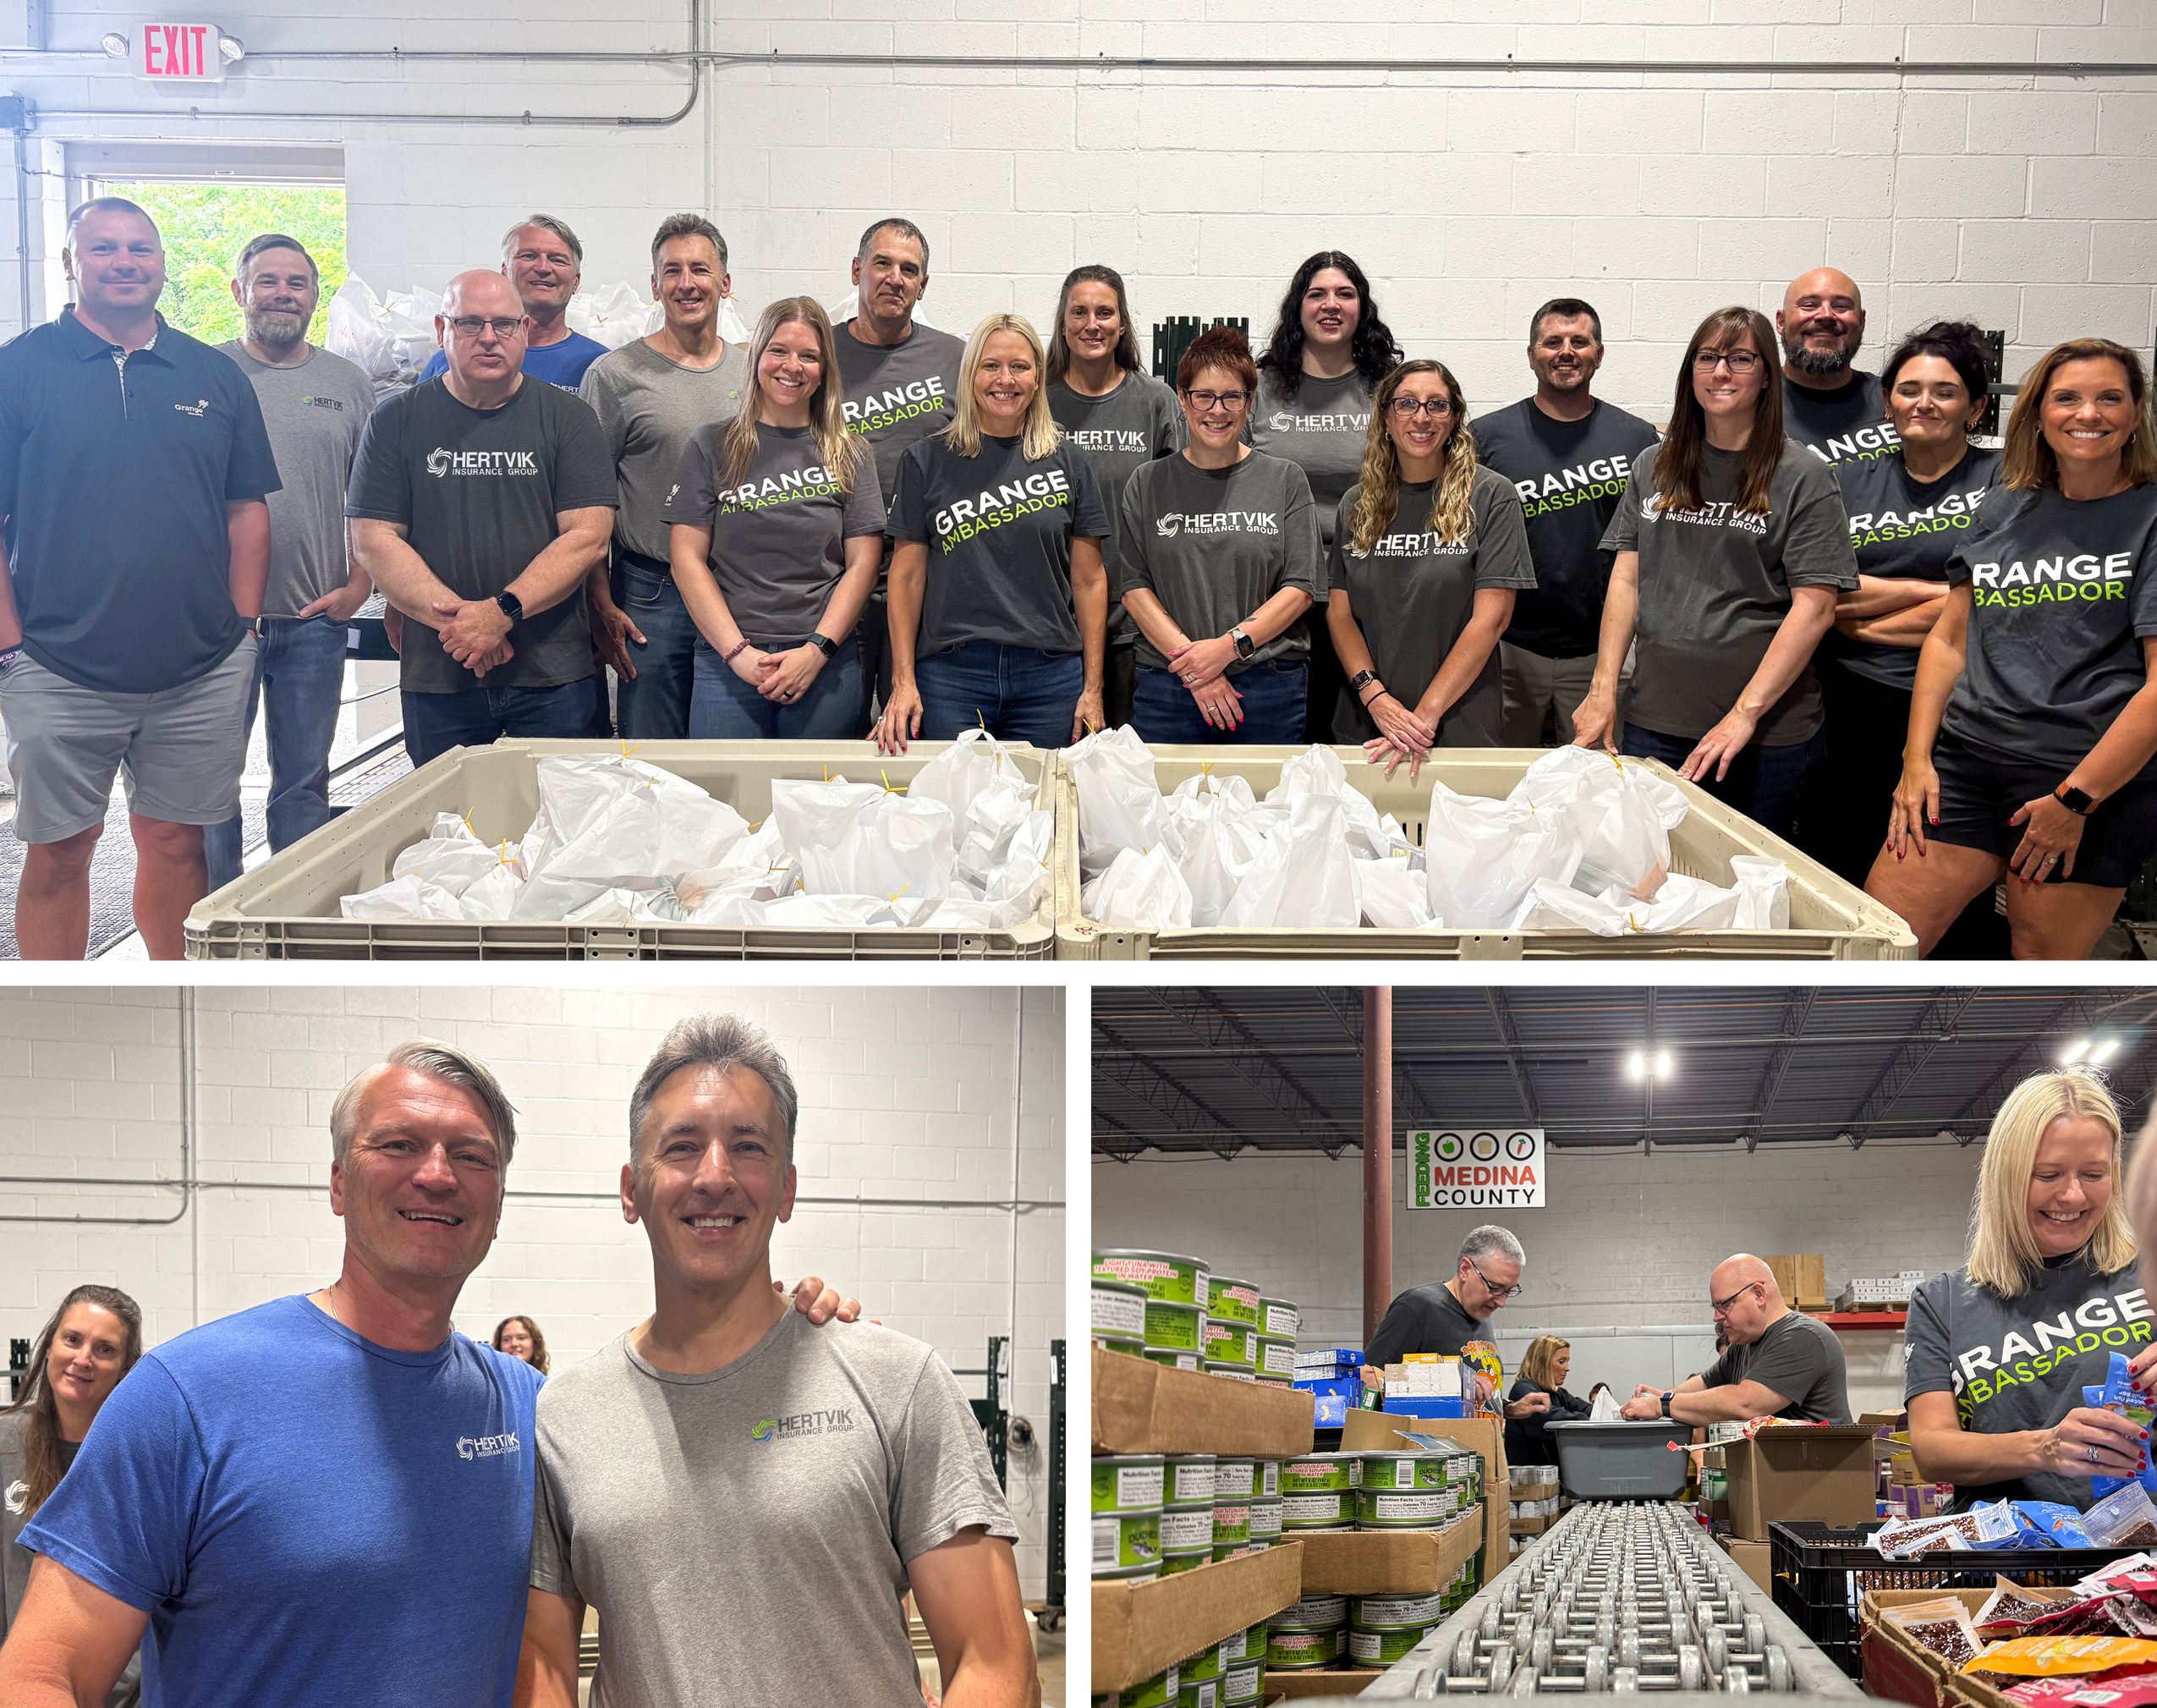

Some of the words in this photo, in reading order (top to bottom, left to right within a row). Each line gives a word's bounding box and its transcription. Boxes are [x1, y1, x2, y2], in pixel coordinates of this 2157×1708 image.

[145, 25, 207, 75] EXIT
[174, 404, 204, 414] Grange
[314, 398, 343, 409] HERTVIK
[841, 376, 946, 423] RANGE
[846, 396, 944, 434] BASSADOR
[1296, 414, 1371, 426] HERTVI
[1066, 430, 1146, 446] HERTVIK
[1807, 422, 1902, 462] ANGE
[453, 451, 536, 468] HERTVIK
[1514, 454, 1632, 503] RANGE
[935, 470, 1069, 535] GRANGE
[1524, 478, 1628, 519] BASSADOR
[1184, 511, 1277, 528] HERTVIK
[1849, 486, 1985, 535] RANGE
[941, 492, 1068, 555] AMBASSADOR
[1184, 524, 1241, 534] INSURANCE
[1246, 525, 1279, 535] GROUP
[1666, 513, 1725, 526] INSURANCE
[1728, 519, 1767, 535] GROUP
[1852, 512, 1974, 549] BASSADO
[1374, 548, 1430, 557] INSURANCE
[1433, 547, 1468, 556] GROUP
[1973, 551, 2132, 589] RANGE
[1975, 581, 2125, 608] BASSADOR
[1415, 1132, 1430, 1206] FEEDING
[1435, 1165, 1536, 1186] MEDINA
[1435, 1189, 1534, 1205] COUNTY
[1147, 1269, 1177, 1277] PROTEIN
[1150, 1261, 1169, 1270] WITH
[778, 1409, 853, 1432] HERTVIK
[777, 1427, 823, 1440] INSURANCE
[477, 1447, 506, 1458] INSURANC
